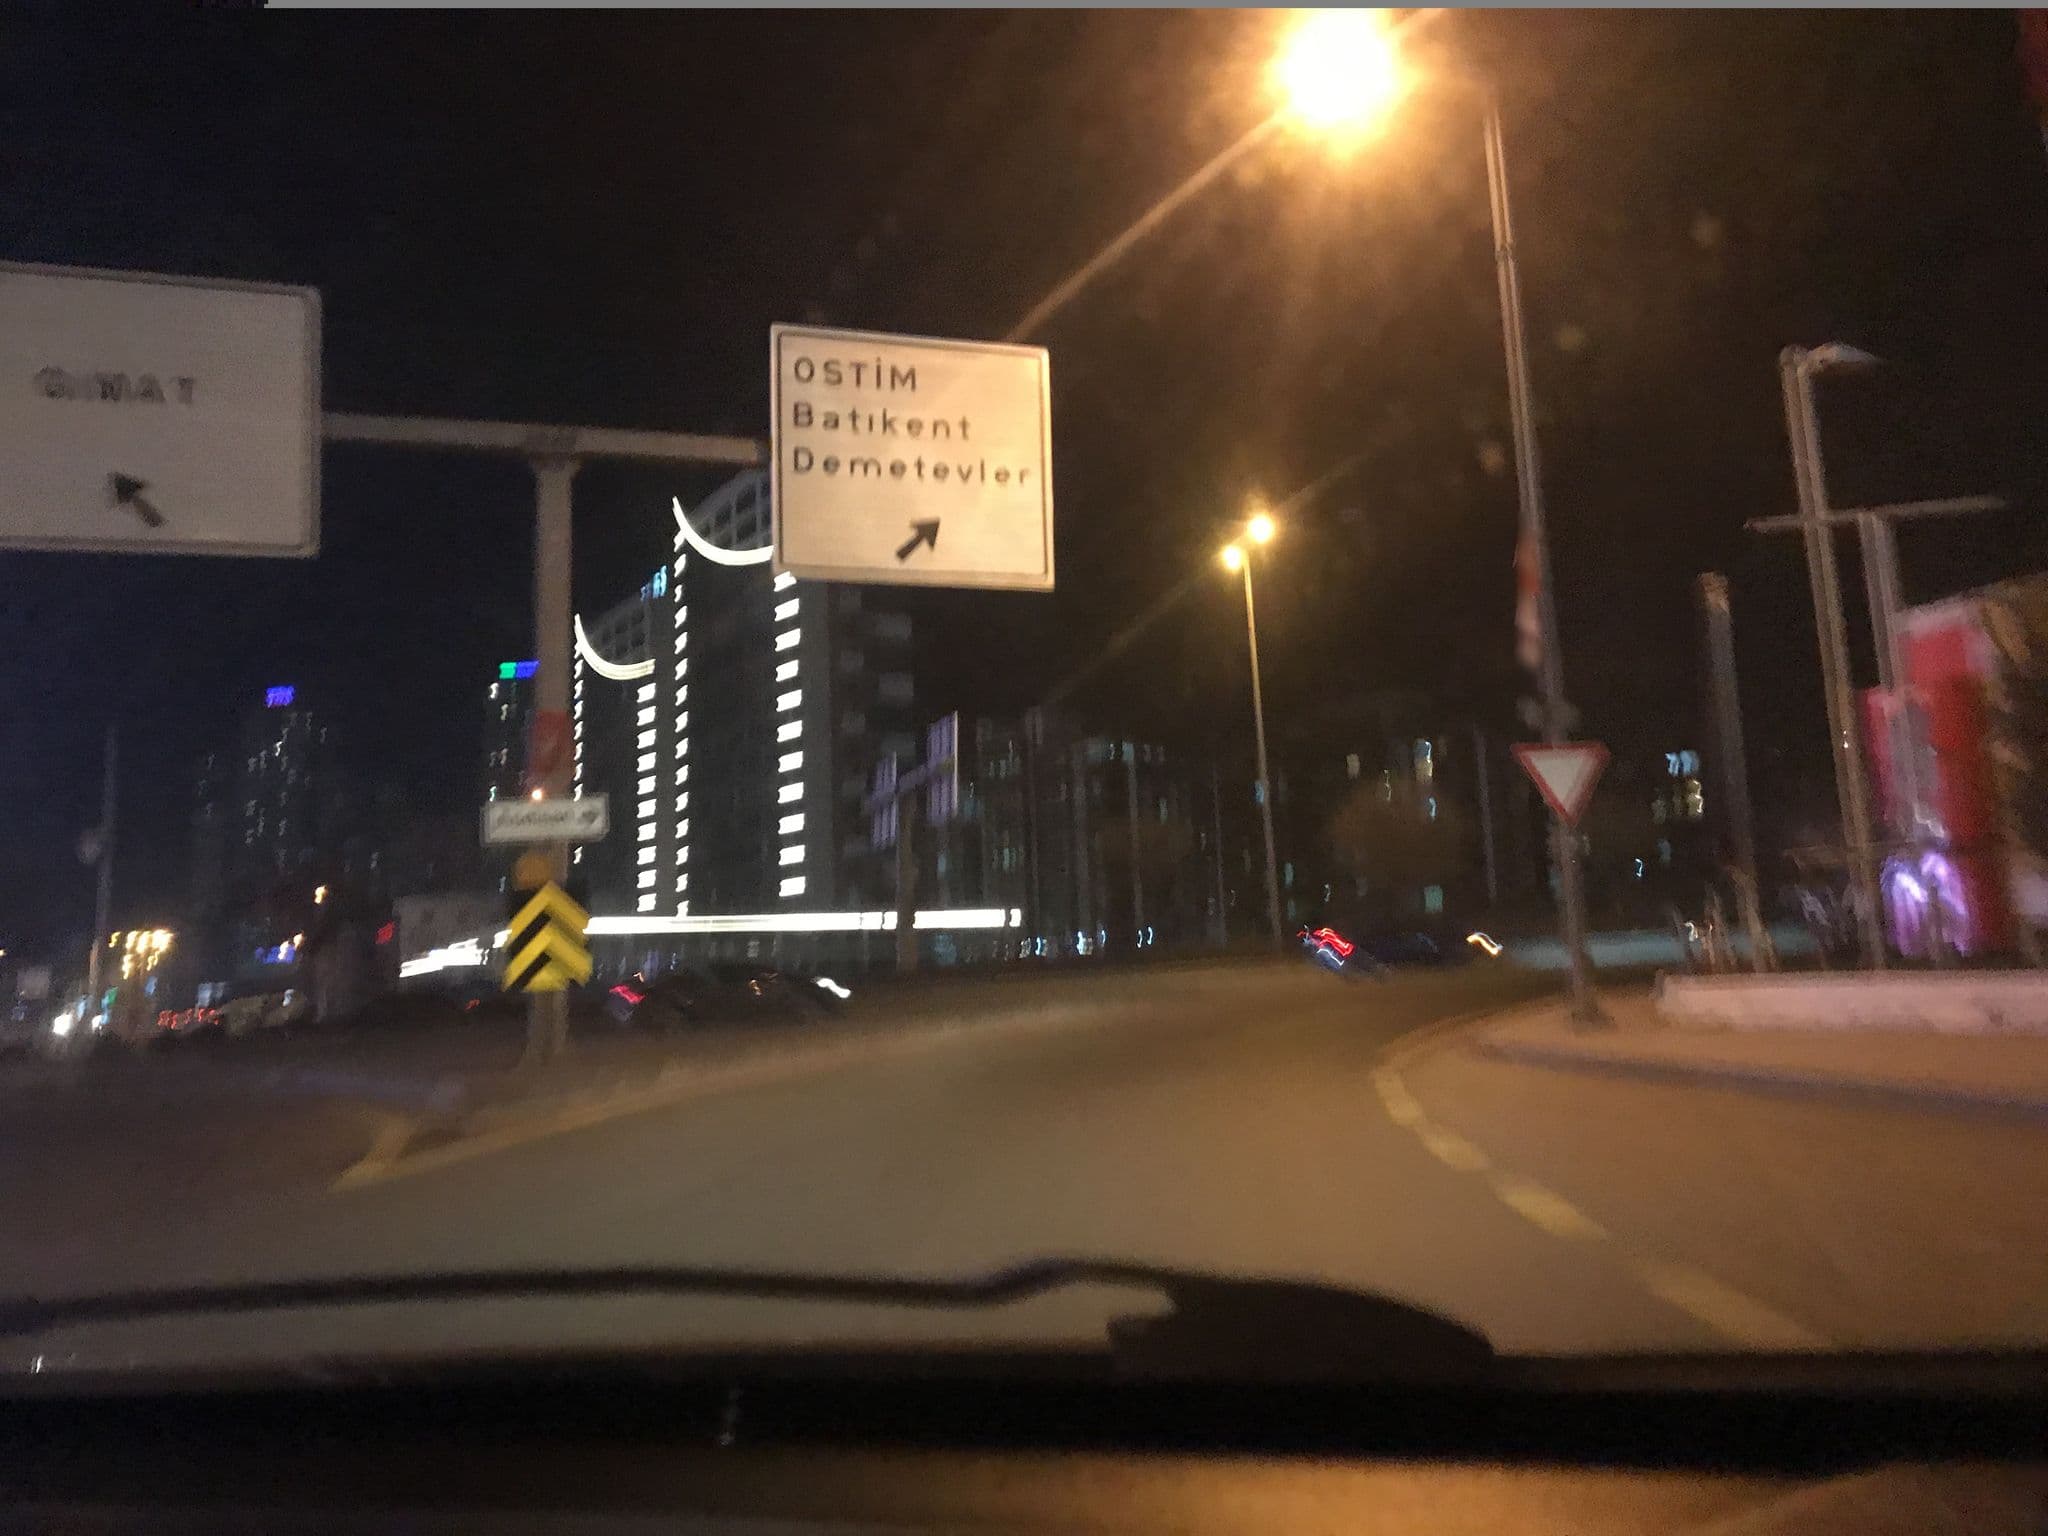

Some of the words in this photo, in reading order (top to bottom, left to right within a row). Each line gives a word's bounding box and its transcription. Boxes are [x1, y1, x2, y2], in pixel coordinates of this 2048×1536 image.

[793, 356, 917, 392] OSTİM
[792, 401, 971, 440] Batıkent
[792, 446, 1031, 487] Demetevler
